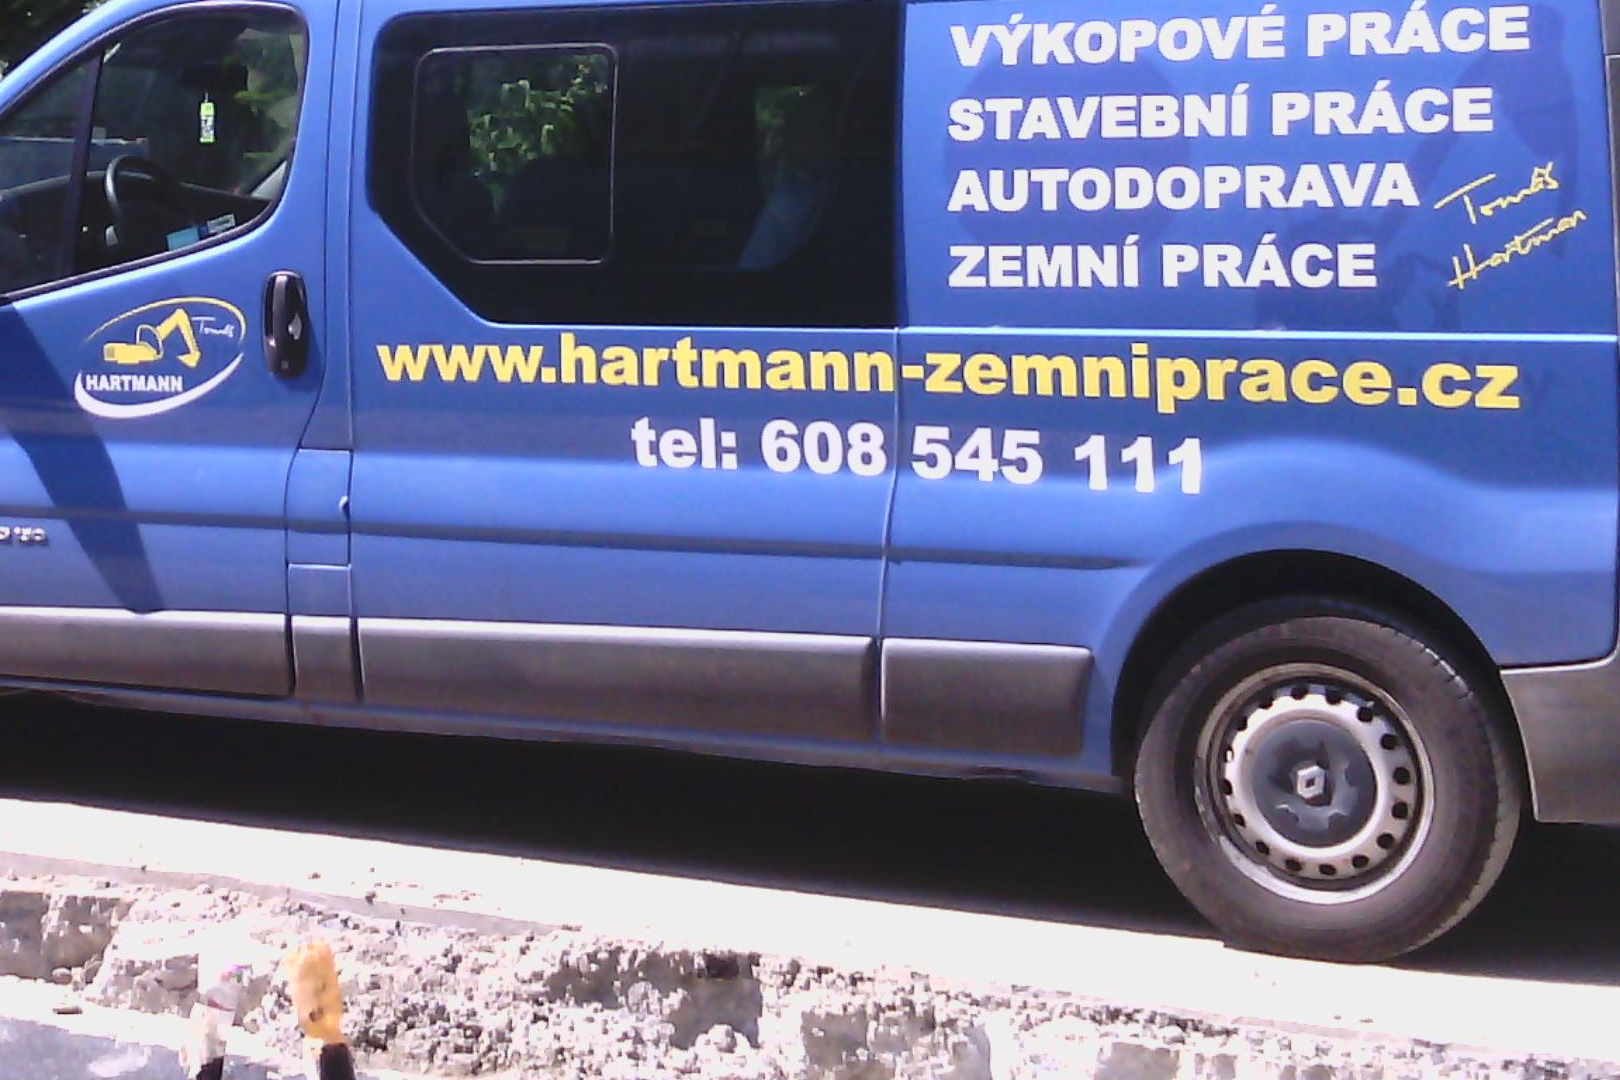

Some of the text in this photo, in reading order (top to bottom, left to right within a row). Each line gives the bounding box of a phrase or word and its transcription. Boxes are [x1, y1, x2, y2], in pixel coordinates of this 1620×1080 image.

[949, 0, 1530, 67] VÝKOPOVÉ PRÁCE
[947, 79, 1494, 142] STAVEBNÍ PRÁCE
[947, 162, 1421, 212] AUTODOPRAVA
[948, 233, 1377, 288] ZEMNÍ PRÁCE
[85, 373, 184, 393] HARTMANN
[376, 332, 1521, 414] www.hartmann-zemniprace.cz
[631, 417, 1203, 495] tel: 608 545 111
